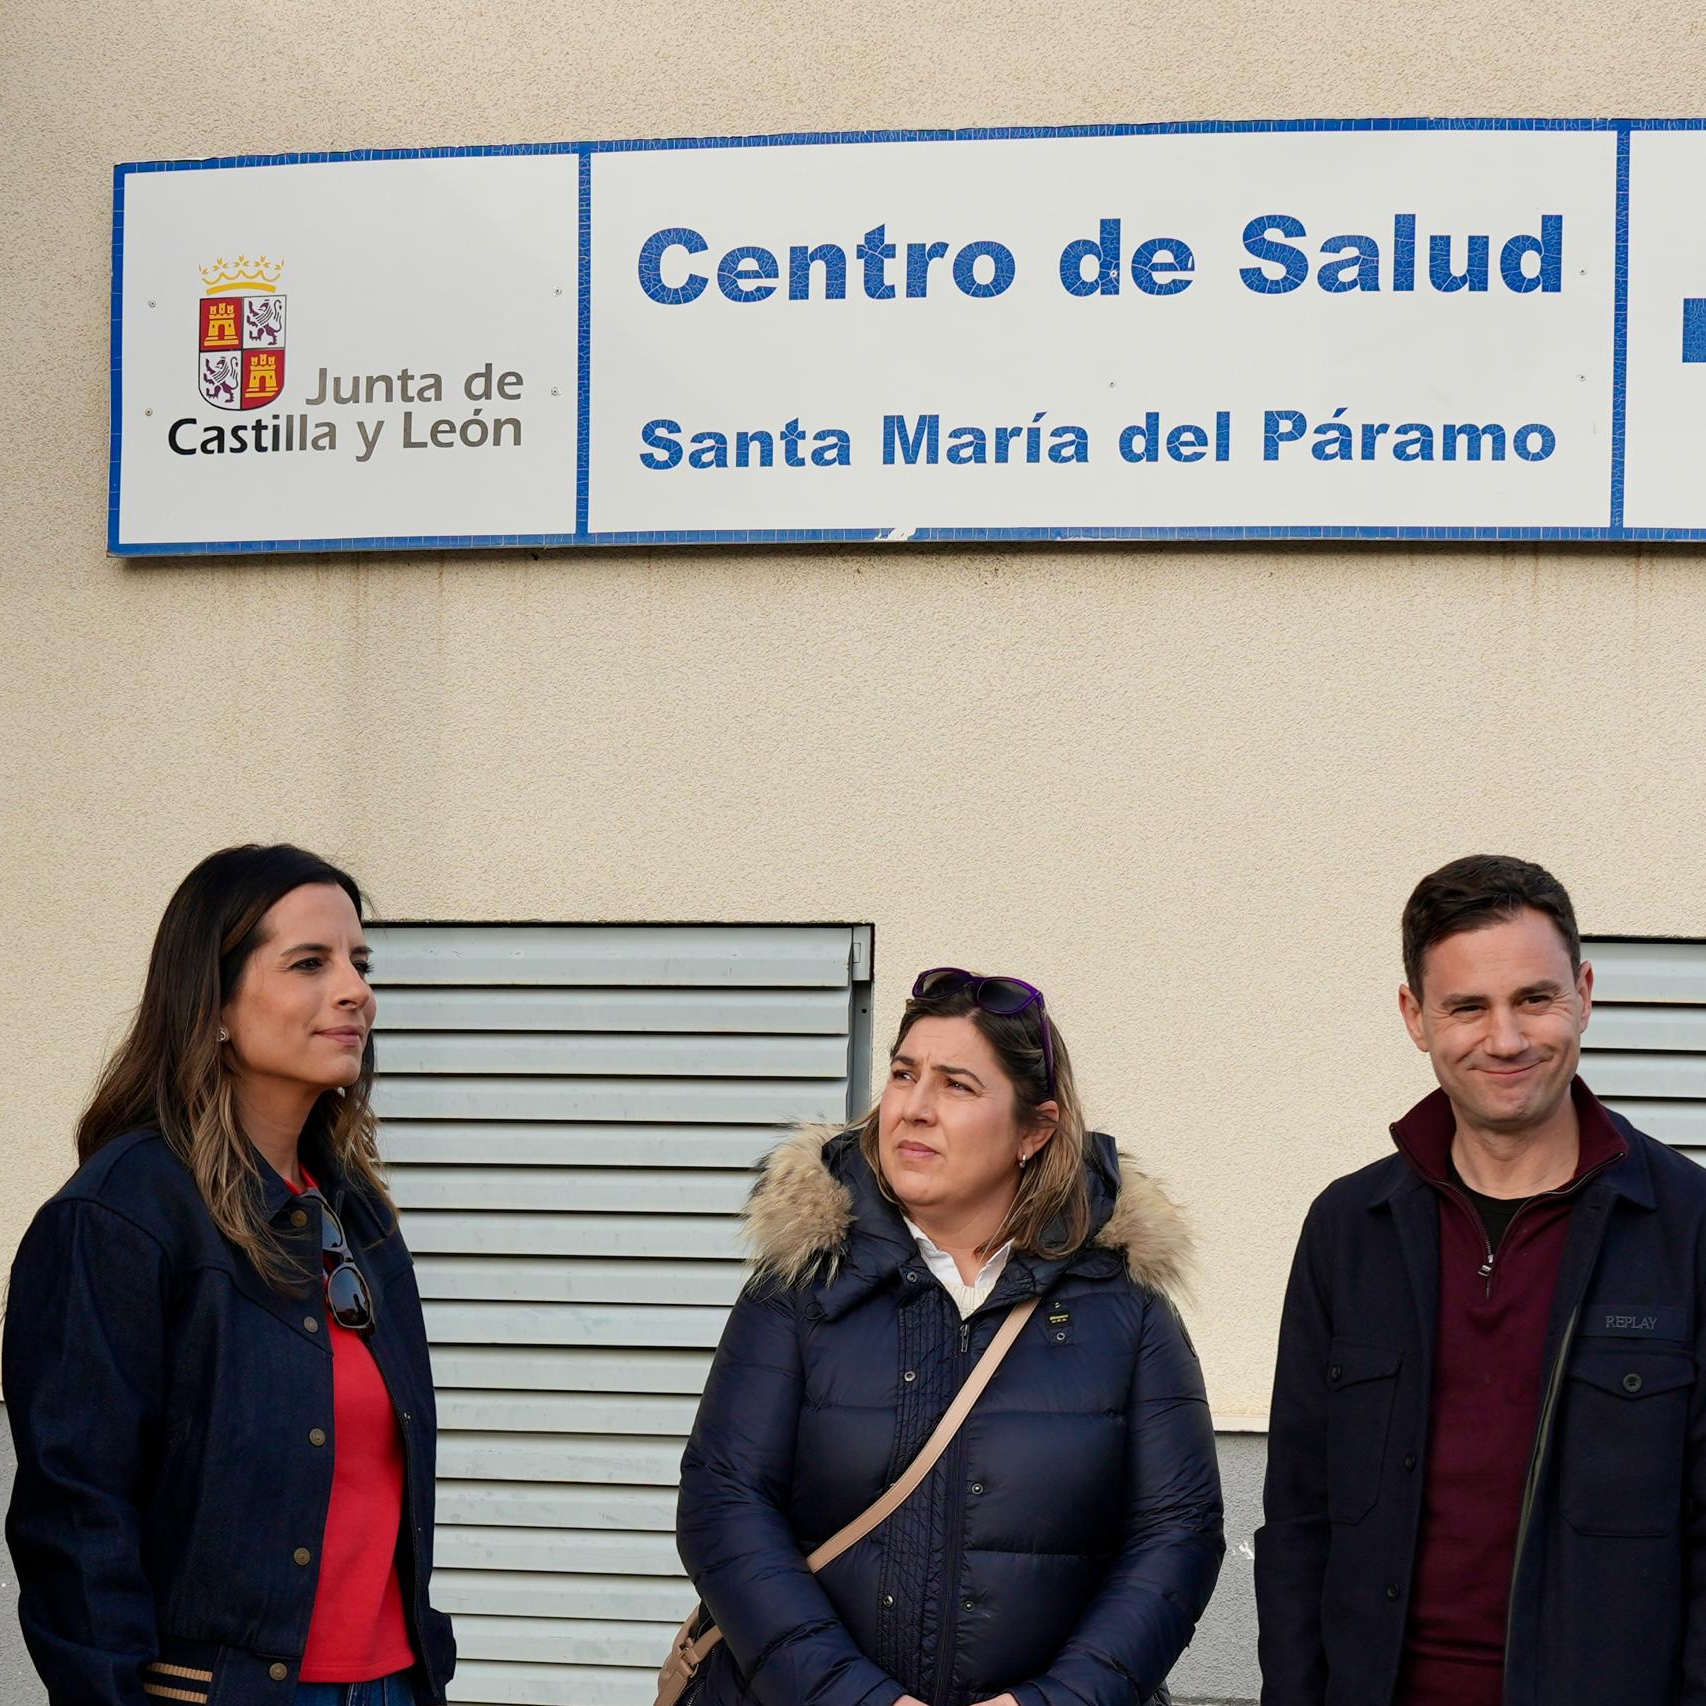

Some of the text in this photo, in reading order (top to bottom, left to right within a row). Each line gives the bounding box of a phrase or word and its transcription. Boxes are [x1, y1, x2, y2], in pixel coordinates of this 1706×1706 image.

[638, 213, 1564, 306] Centro de Salud
[305, 362, 524, 406] Junta de
[167, 409, 522, 463] Castilla y León
[638, 406, 1557, 470] Santa María del Páramo
[1605, 1315, 1657, 1329] REPLAY
